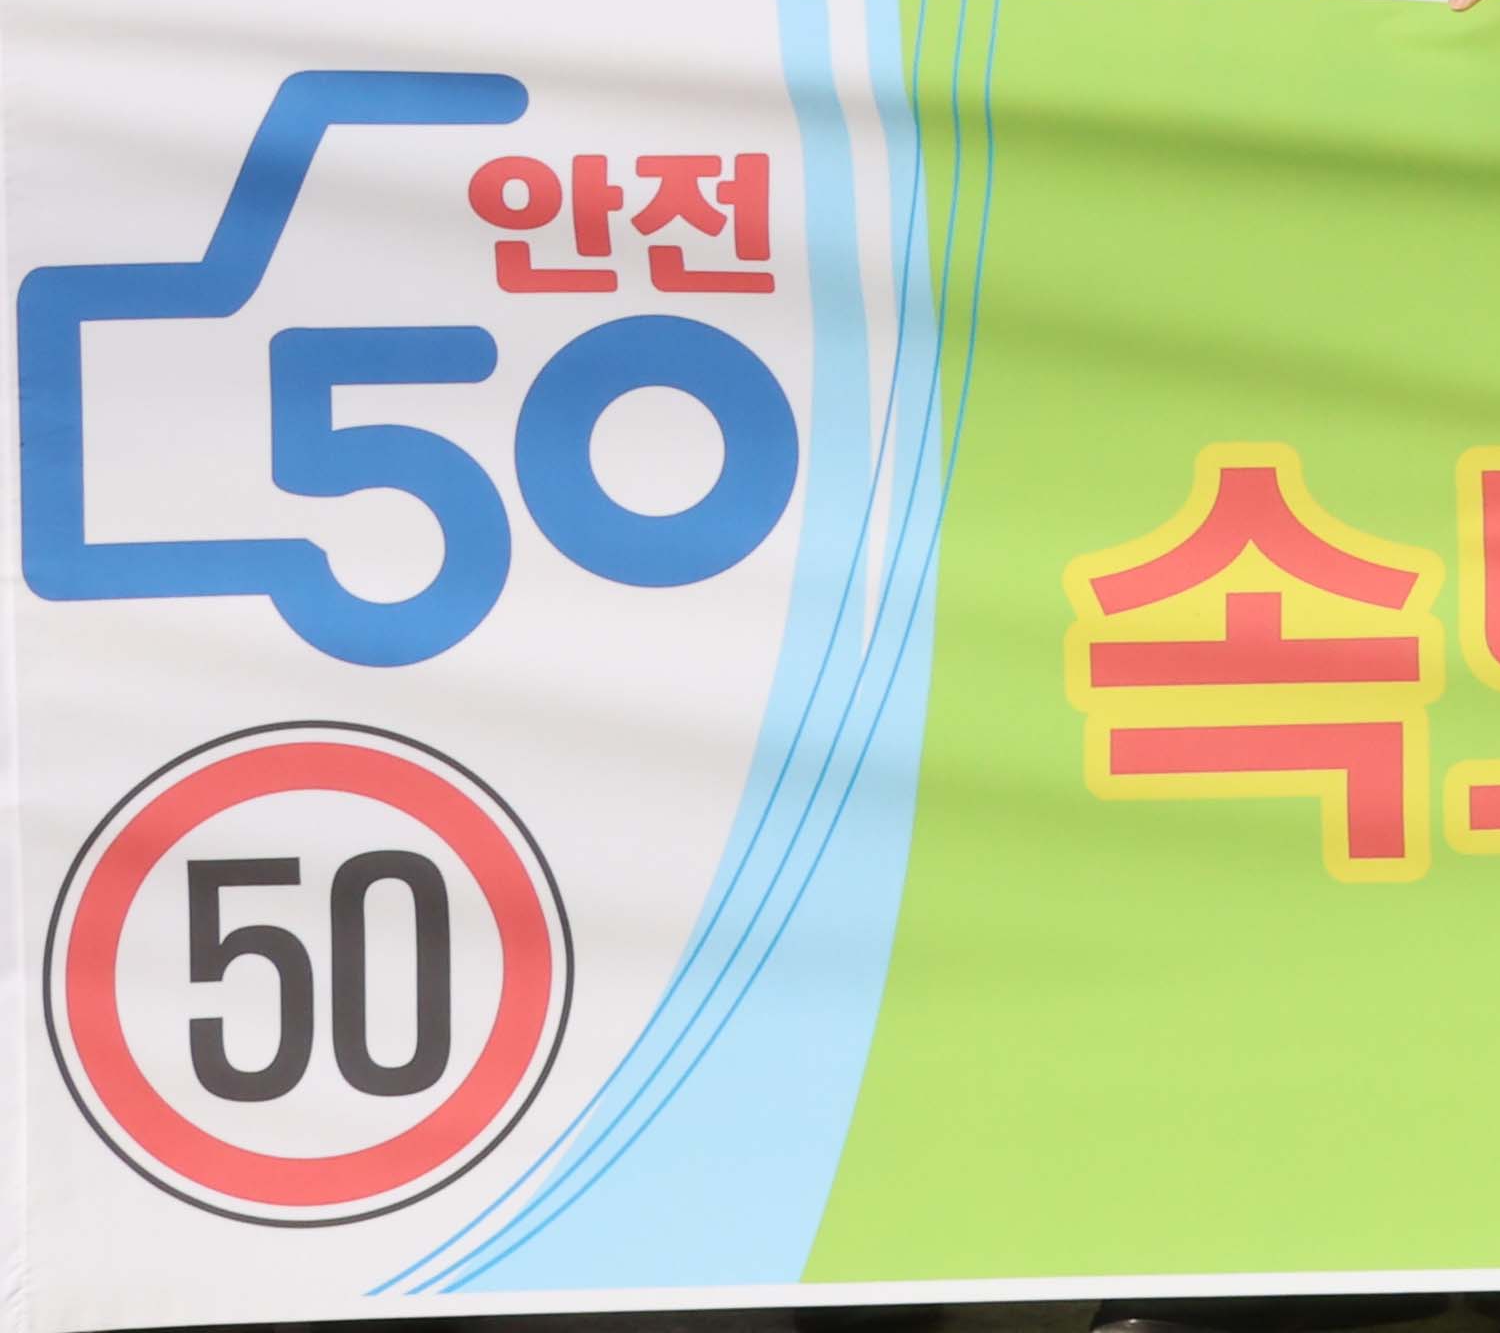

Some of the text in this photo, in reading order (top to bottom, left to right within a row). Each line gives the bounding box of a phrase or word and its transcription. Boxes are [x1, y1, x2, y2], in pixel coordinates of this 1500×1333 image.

[467, 151, 775, 294] 안전
[268, 312, 800, 669] 50
[185, 849, 452, 1103] 50
